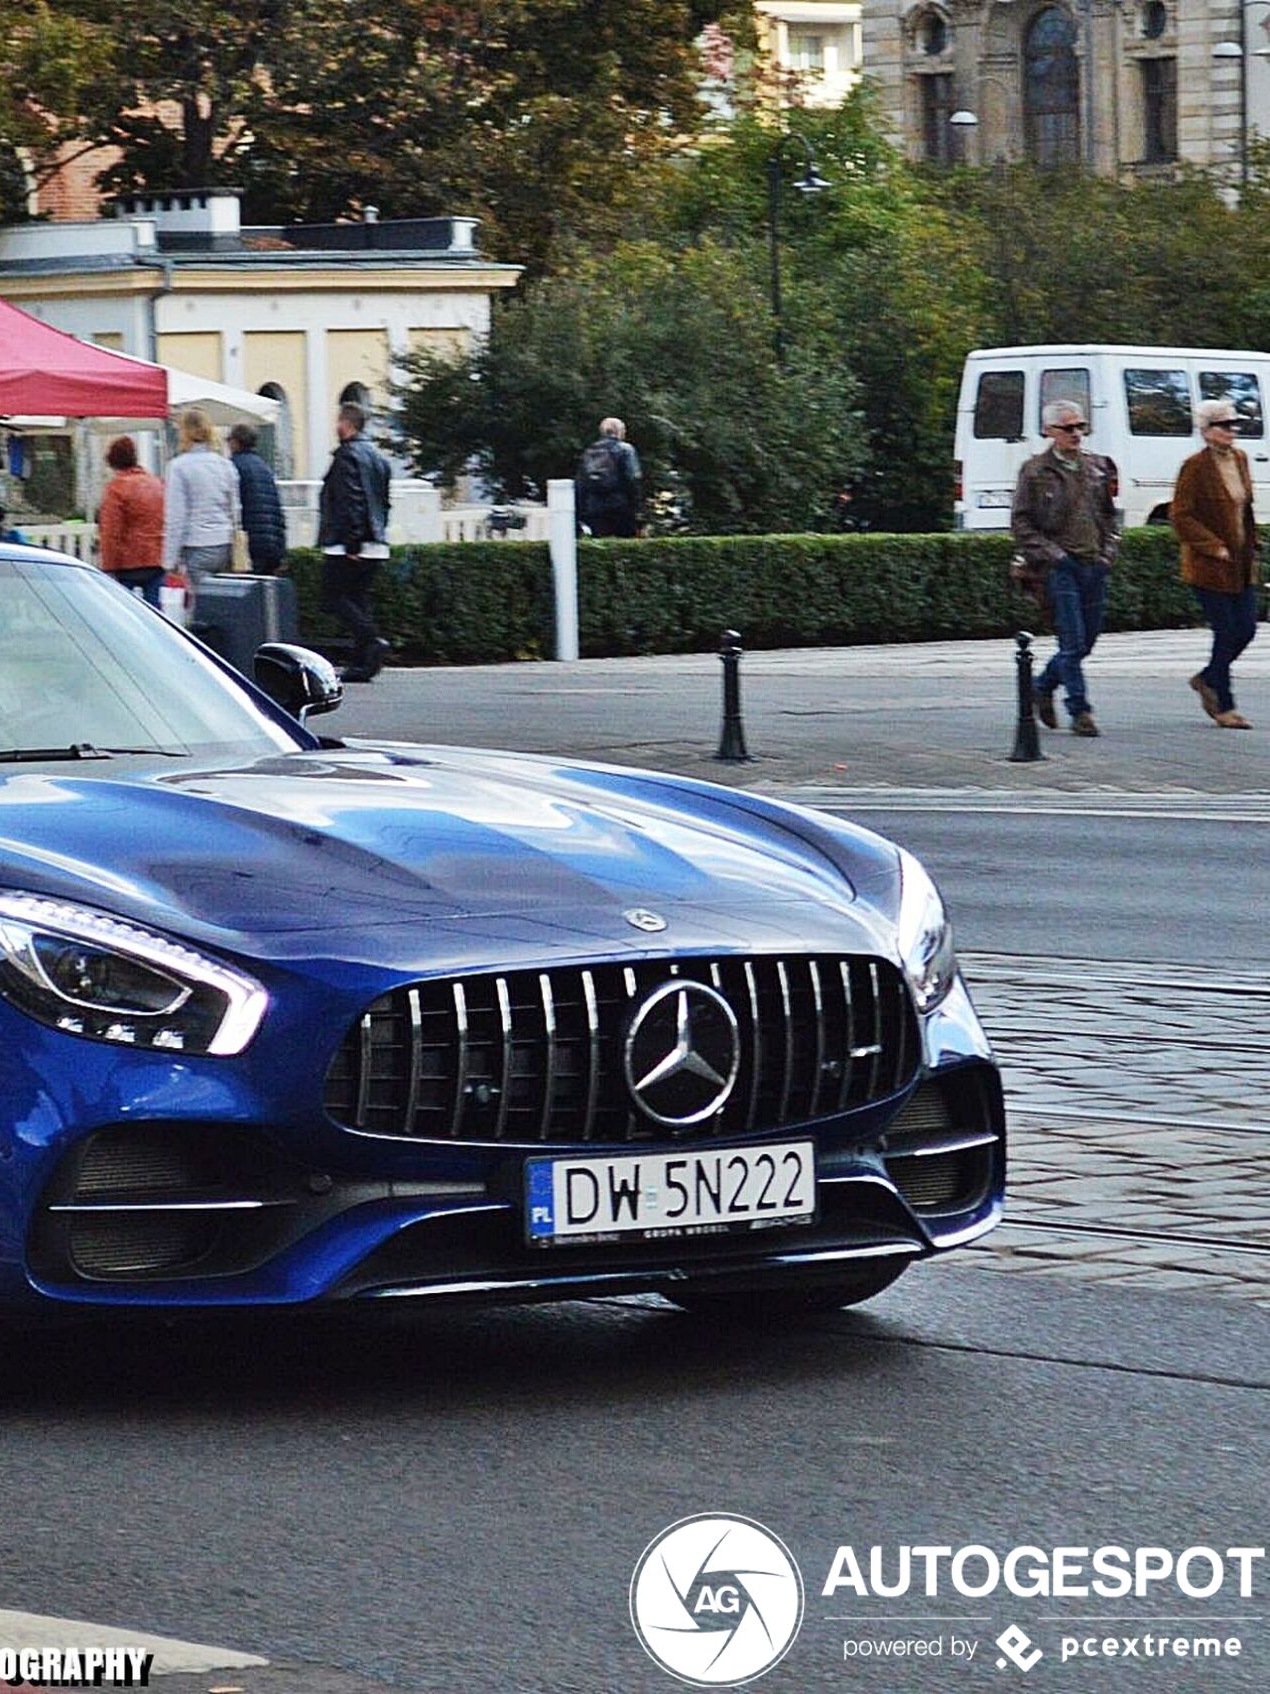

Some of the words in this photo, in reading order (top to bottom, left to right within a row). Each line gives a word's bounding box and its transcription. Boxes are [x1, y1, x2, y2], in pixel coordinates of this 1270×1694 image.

[566, 1163, 640, 1225] DW
[664, 1150, 804, 1218] 5N222
[531, 1206, 552, 1224] PL
